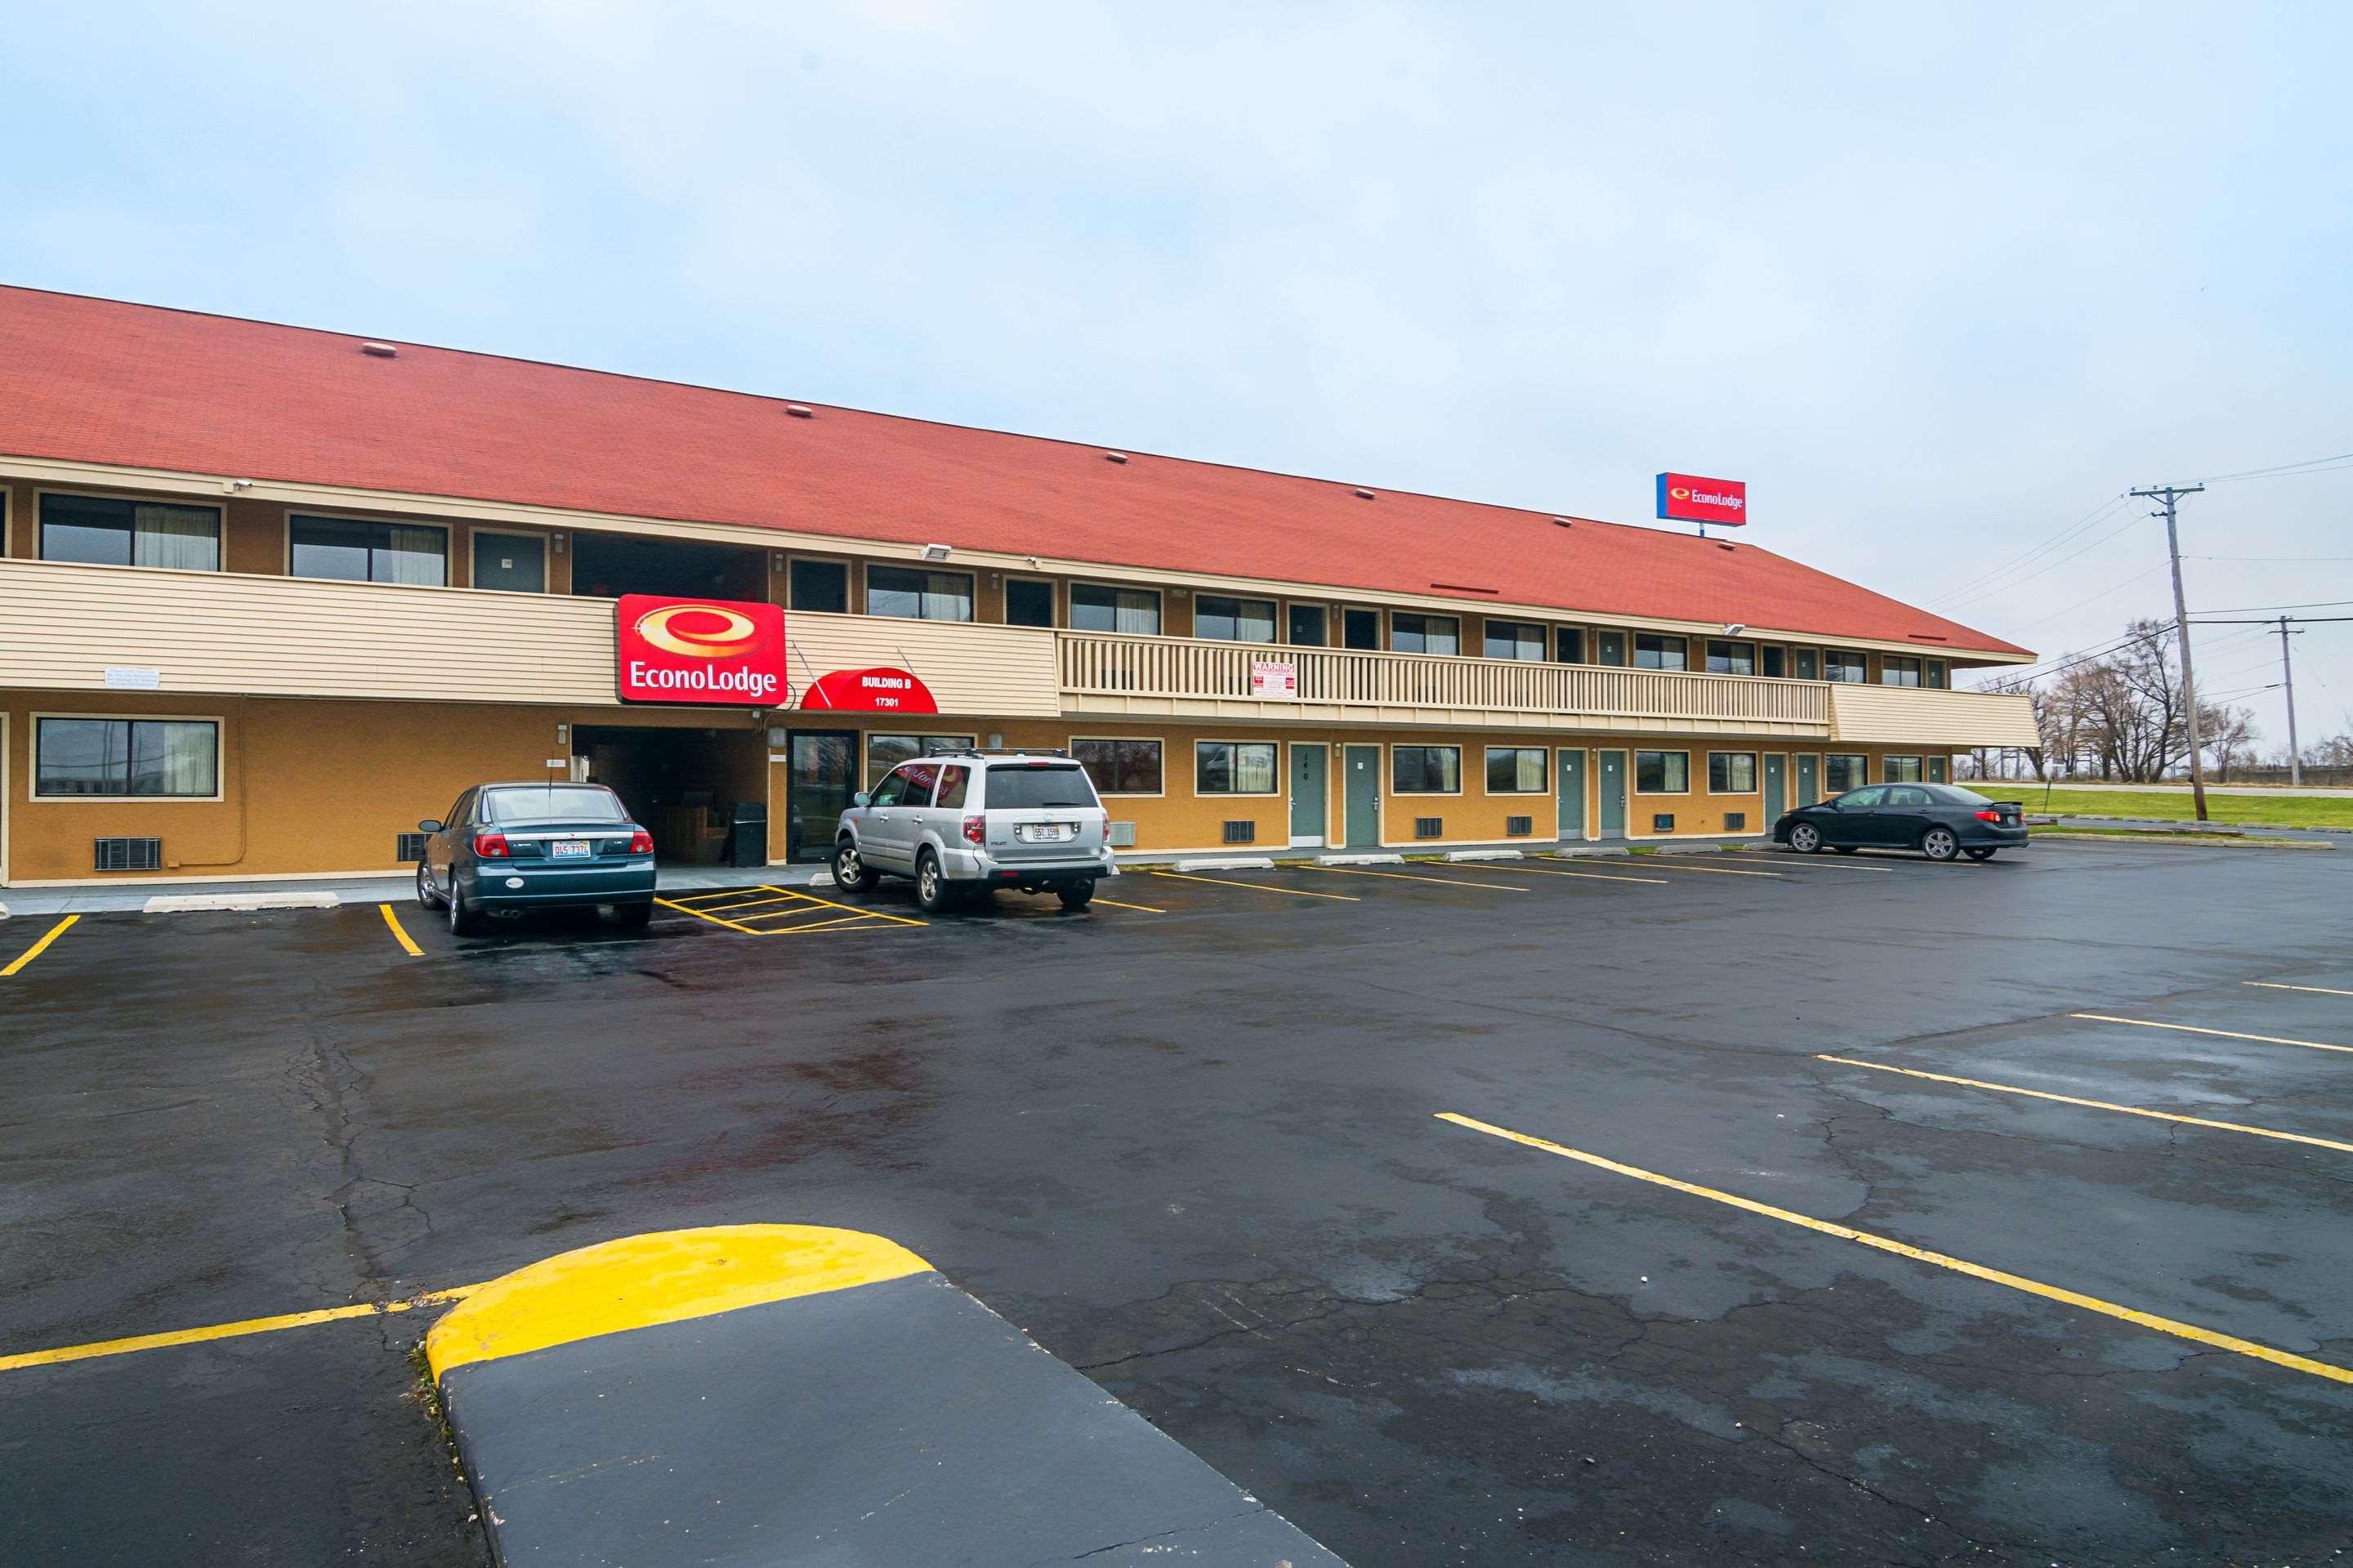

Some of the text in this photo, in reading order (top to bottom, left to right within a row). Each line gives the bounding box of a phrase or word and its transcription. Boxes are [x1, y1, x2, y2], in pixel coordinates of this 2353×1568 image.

[1691, 489, 1743, 510] EconoLodge
[1254, 663, 1294, 673] WARNING
[630, 661, 777, 698] EconoLodge
[862, 677, 912, 689] BUILDING B
[875, 697, 899, 707] 17301
